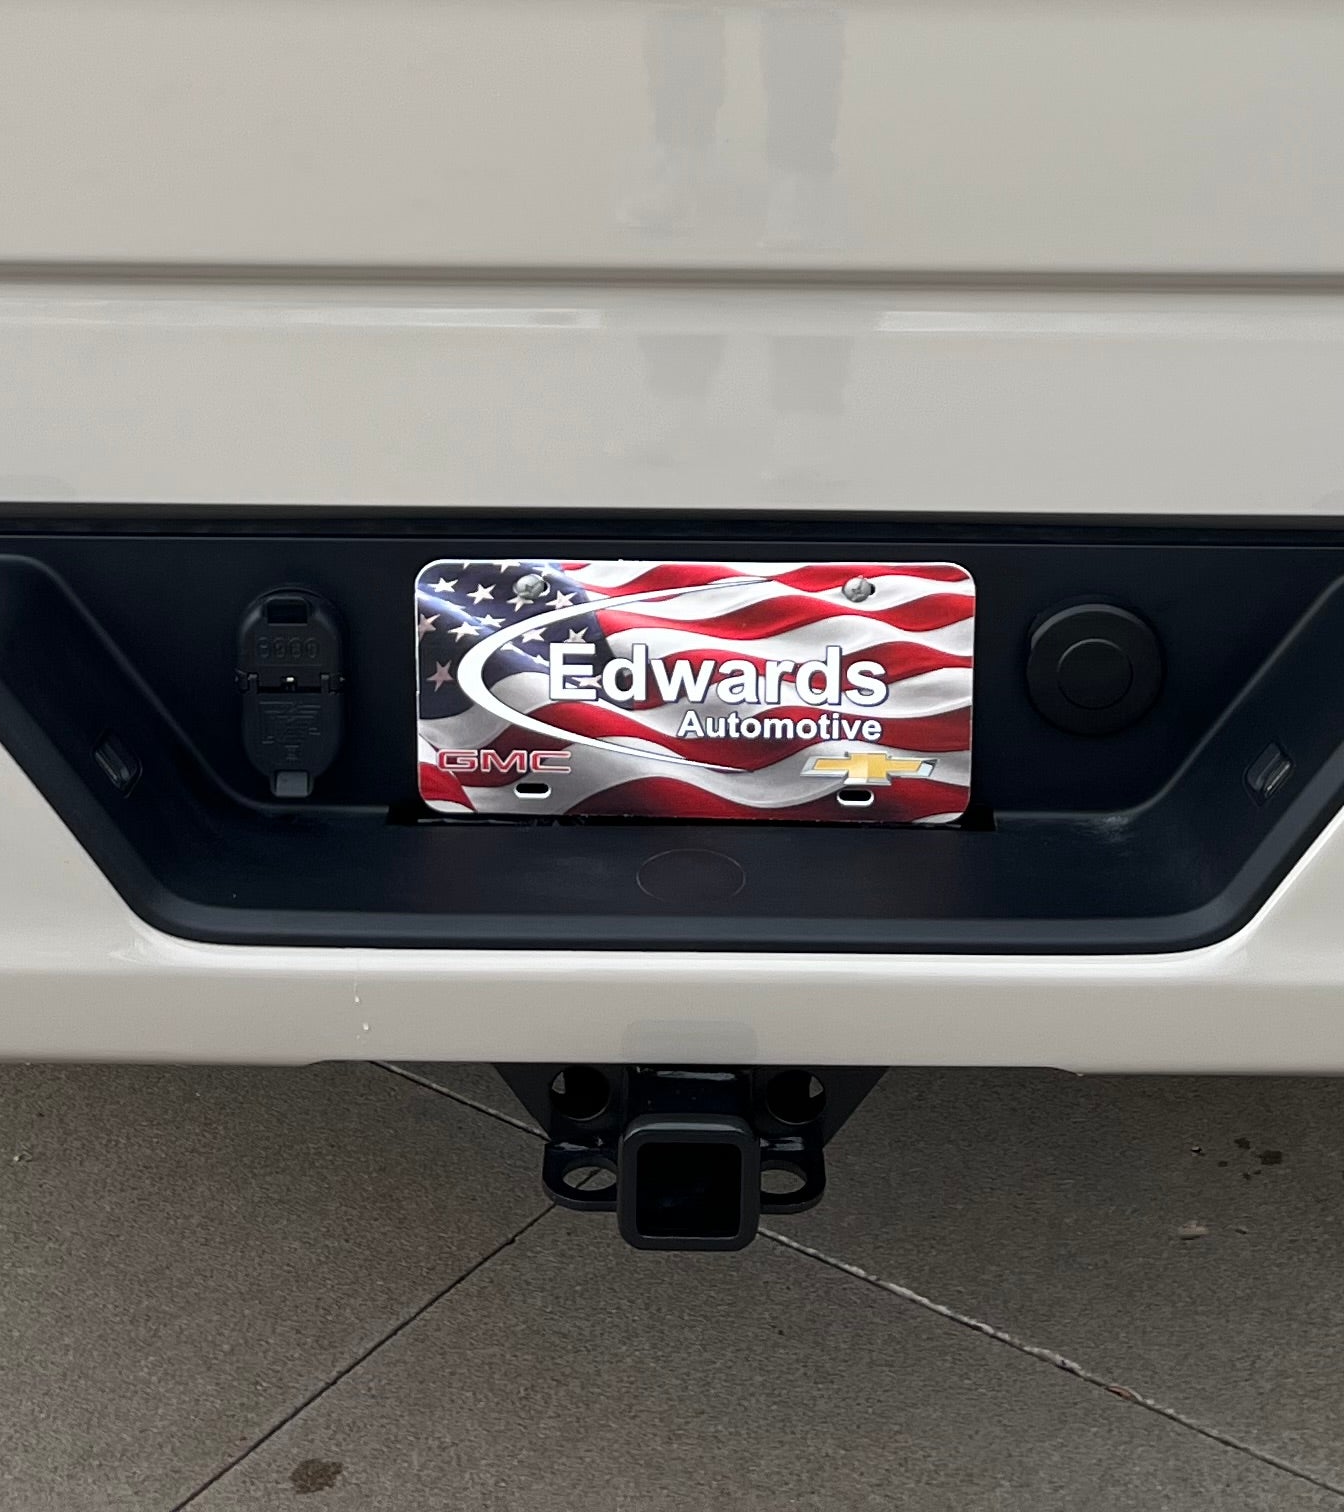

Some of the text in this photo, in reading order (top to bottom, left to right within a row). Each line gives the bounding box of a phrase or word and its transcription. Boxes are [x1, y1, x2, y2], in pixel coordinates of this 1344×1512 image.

[547, 642, 889, 707] Edwards
[677, 710, 882, 742] Automotive
[436, 749, 572, 774] GMC
